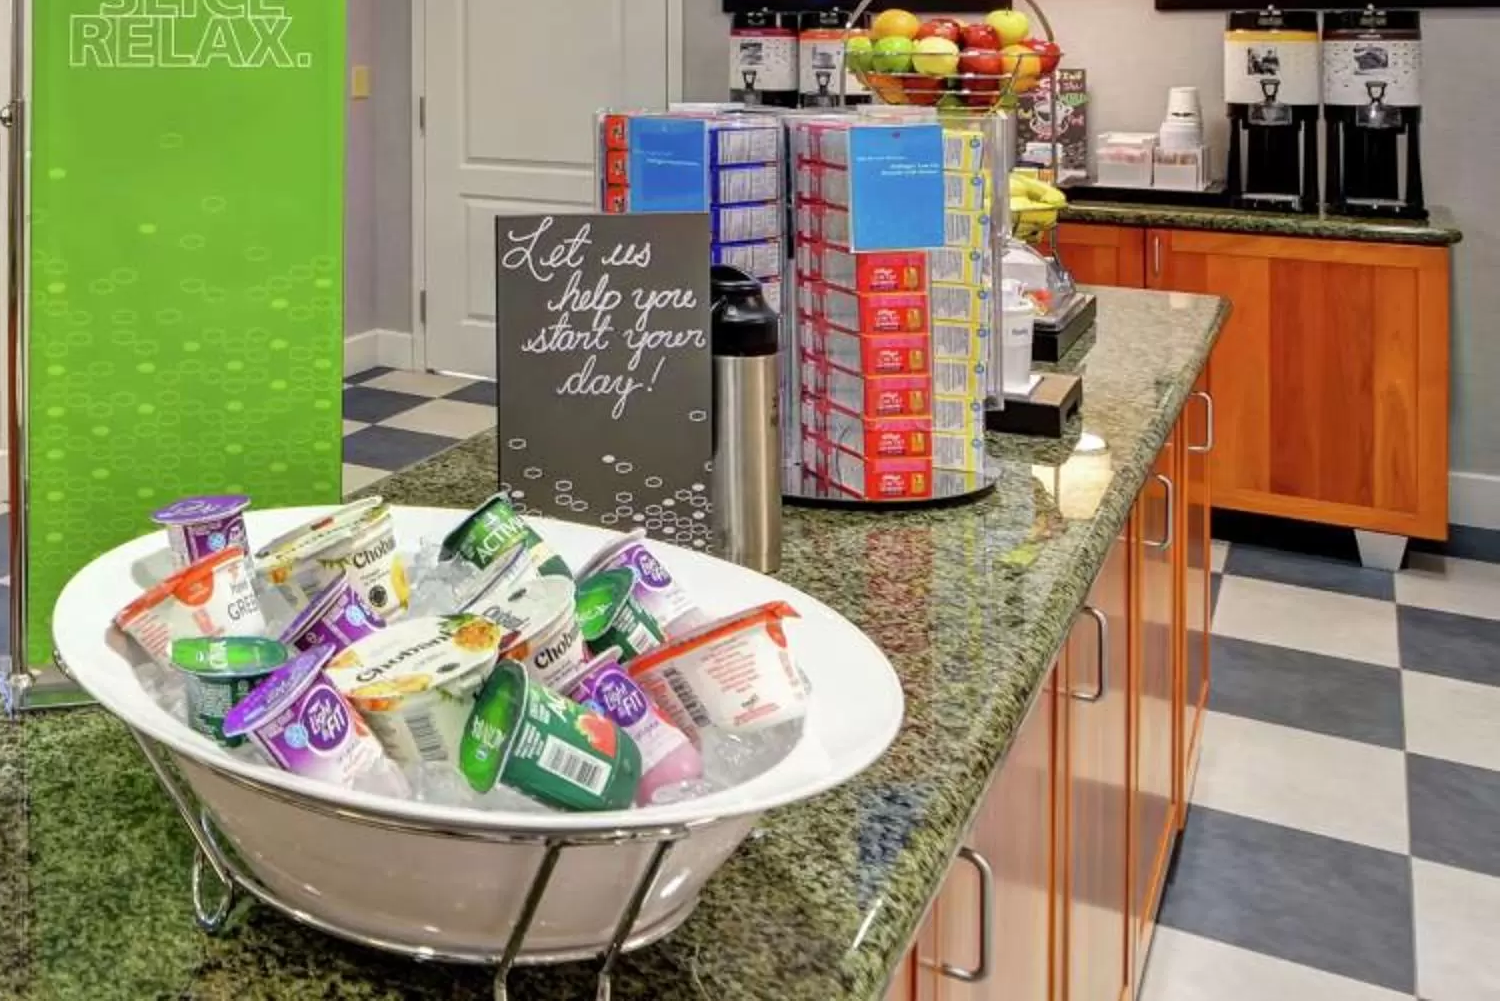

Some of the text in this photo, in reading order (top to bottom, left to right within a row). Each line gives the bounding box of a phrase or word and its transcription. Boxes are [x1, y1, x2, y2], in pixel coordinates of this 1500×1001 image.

[69, 15, 312, 68] RELAX.
[502, 216, 651, 282] Let us
[548, 269, 698, 331] help you
[521, 312, 707, 372] start your
[556, 354, 666, 420] day!
[476, 515, 525, 566] ACTIV
